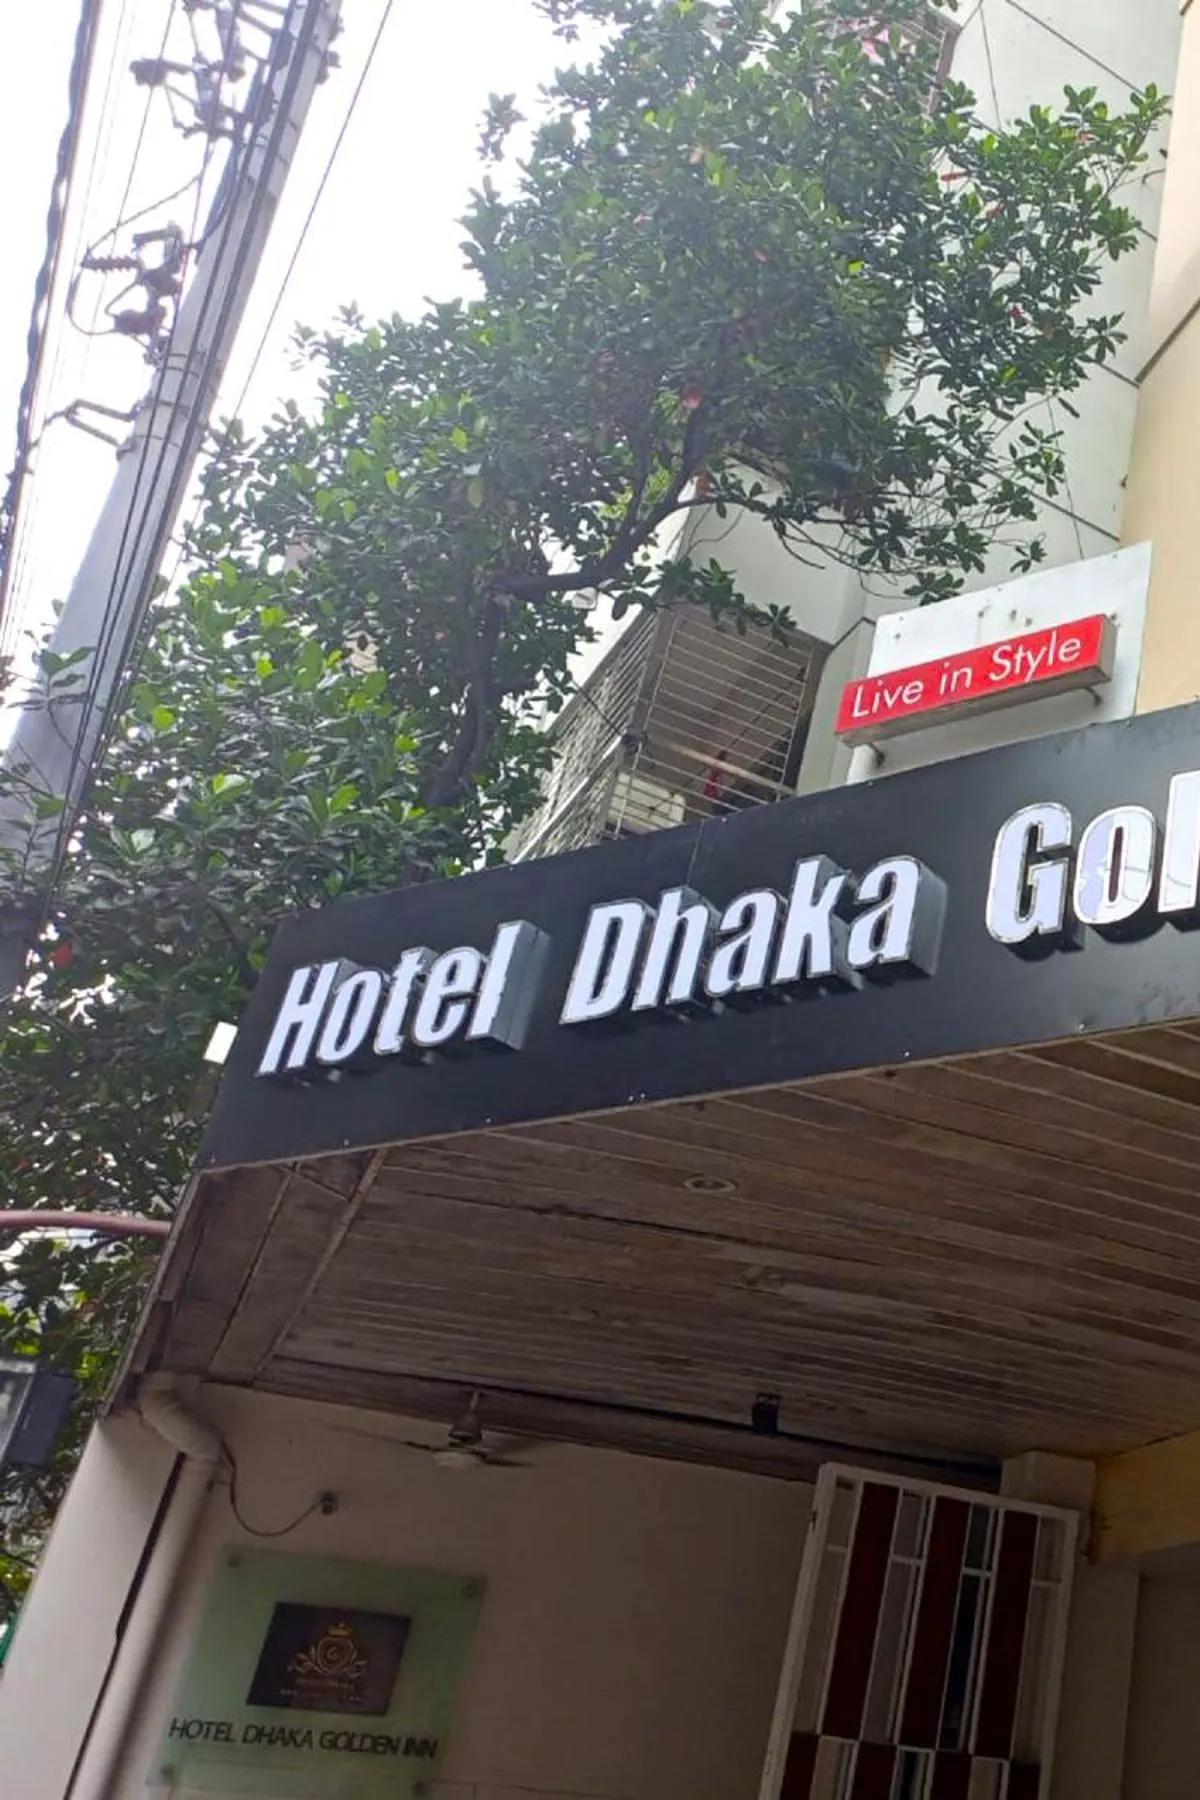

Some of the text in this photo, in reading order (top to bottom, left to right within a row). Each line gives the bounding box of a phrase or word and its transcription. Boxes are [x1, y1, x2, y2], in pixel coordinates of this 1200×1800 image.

[852, 629, 1082, 718] Live in Style
[256, 920, 529, 1078] Hotel
[558, 854, 924, 1026] Dhaka
[168, 1717, 439, 1759] HOTEL DHAKA GOLDEN INN
